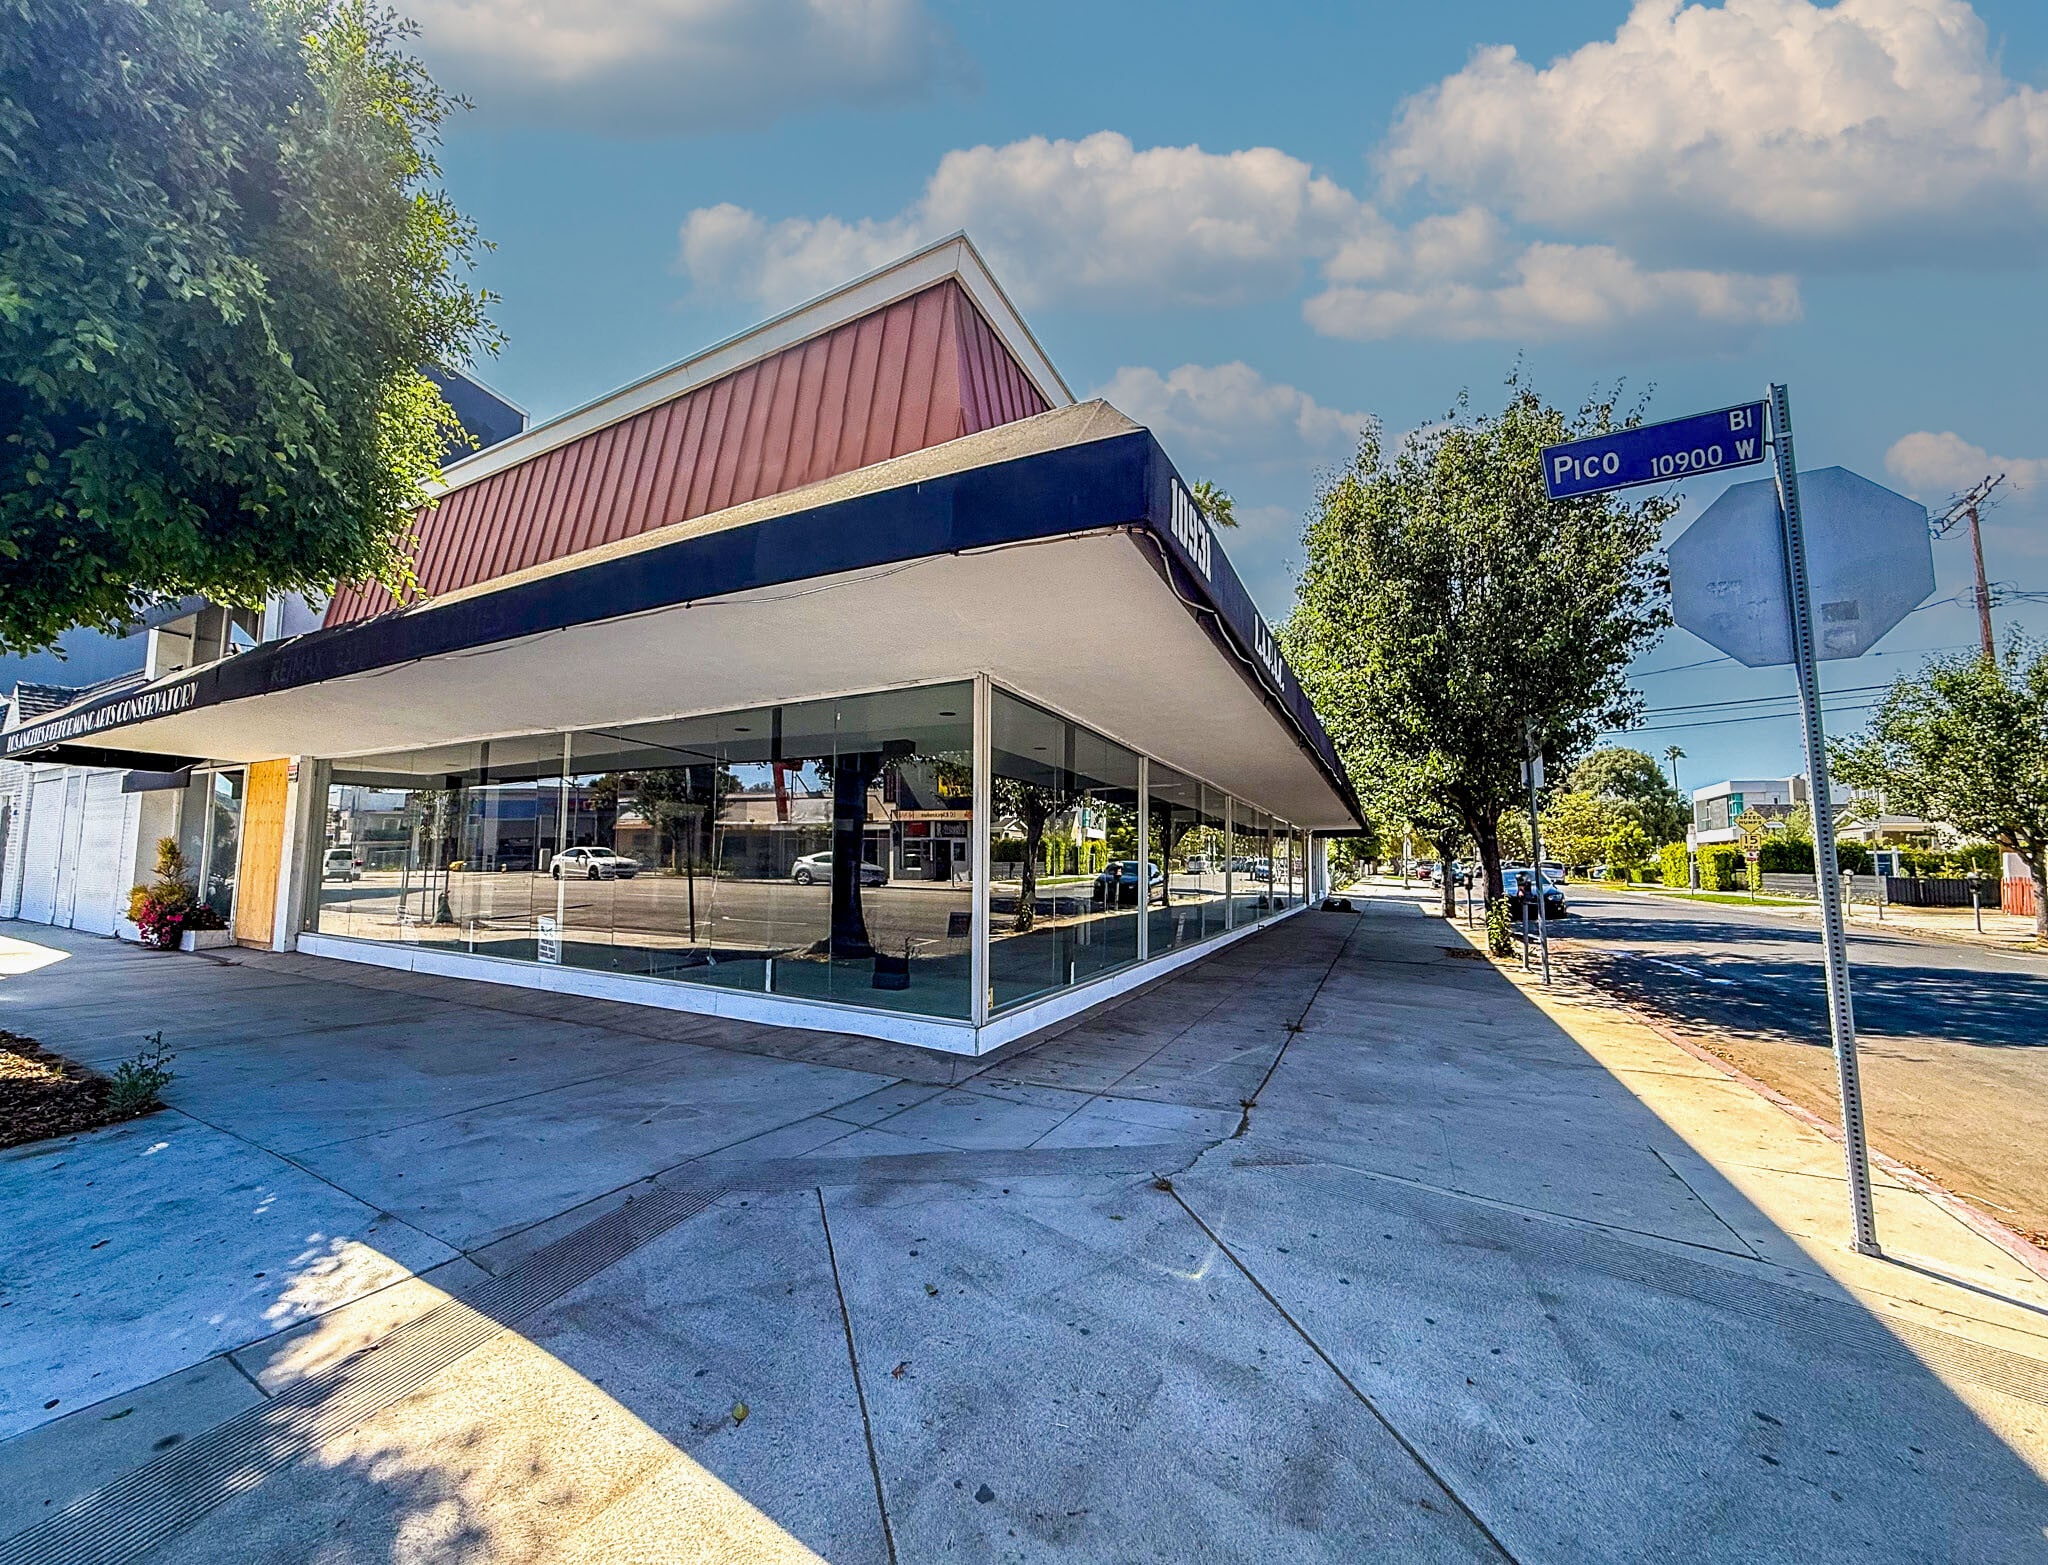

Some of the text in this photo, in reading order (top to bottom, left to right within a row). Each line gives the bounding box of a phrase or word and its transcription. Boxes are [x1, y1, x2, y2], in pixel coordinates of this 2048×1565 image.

[1650, 444, 1723, 477] 10900
[1735, 438, 1755, 460] W
[1170, 477, 1212, 583] 10931
[94, 704, 117, 729] ARTS
[116, 681, 200, 724] CONSERVATORY
[1744, 835, 1758, 845] 15
